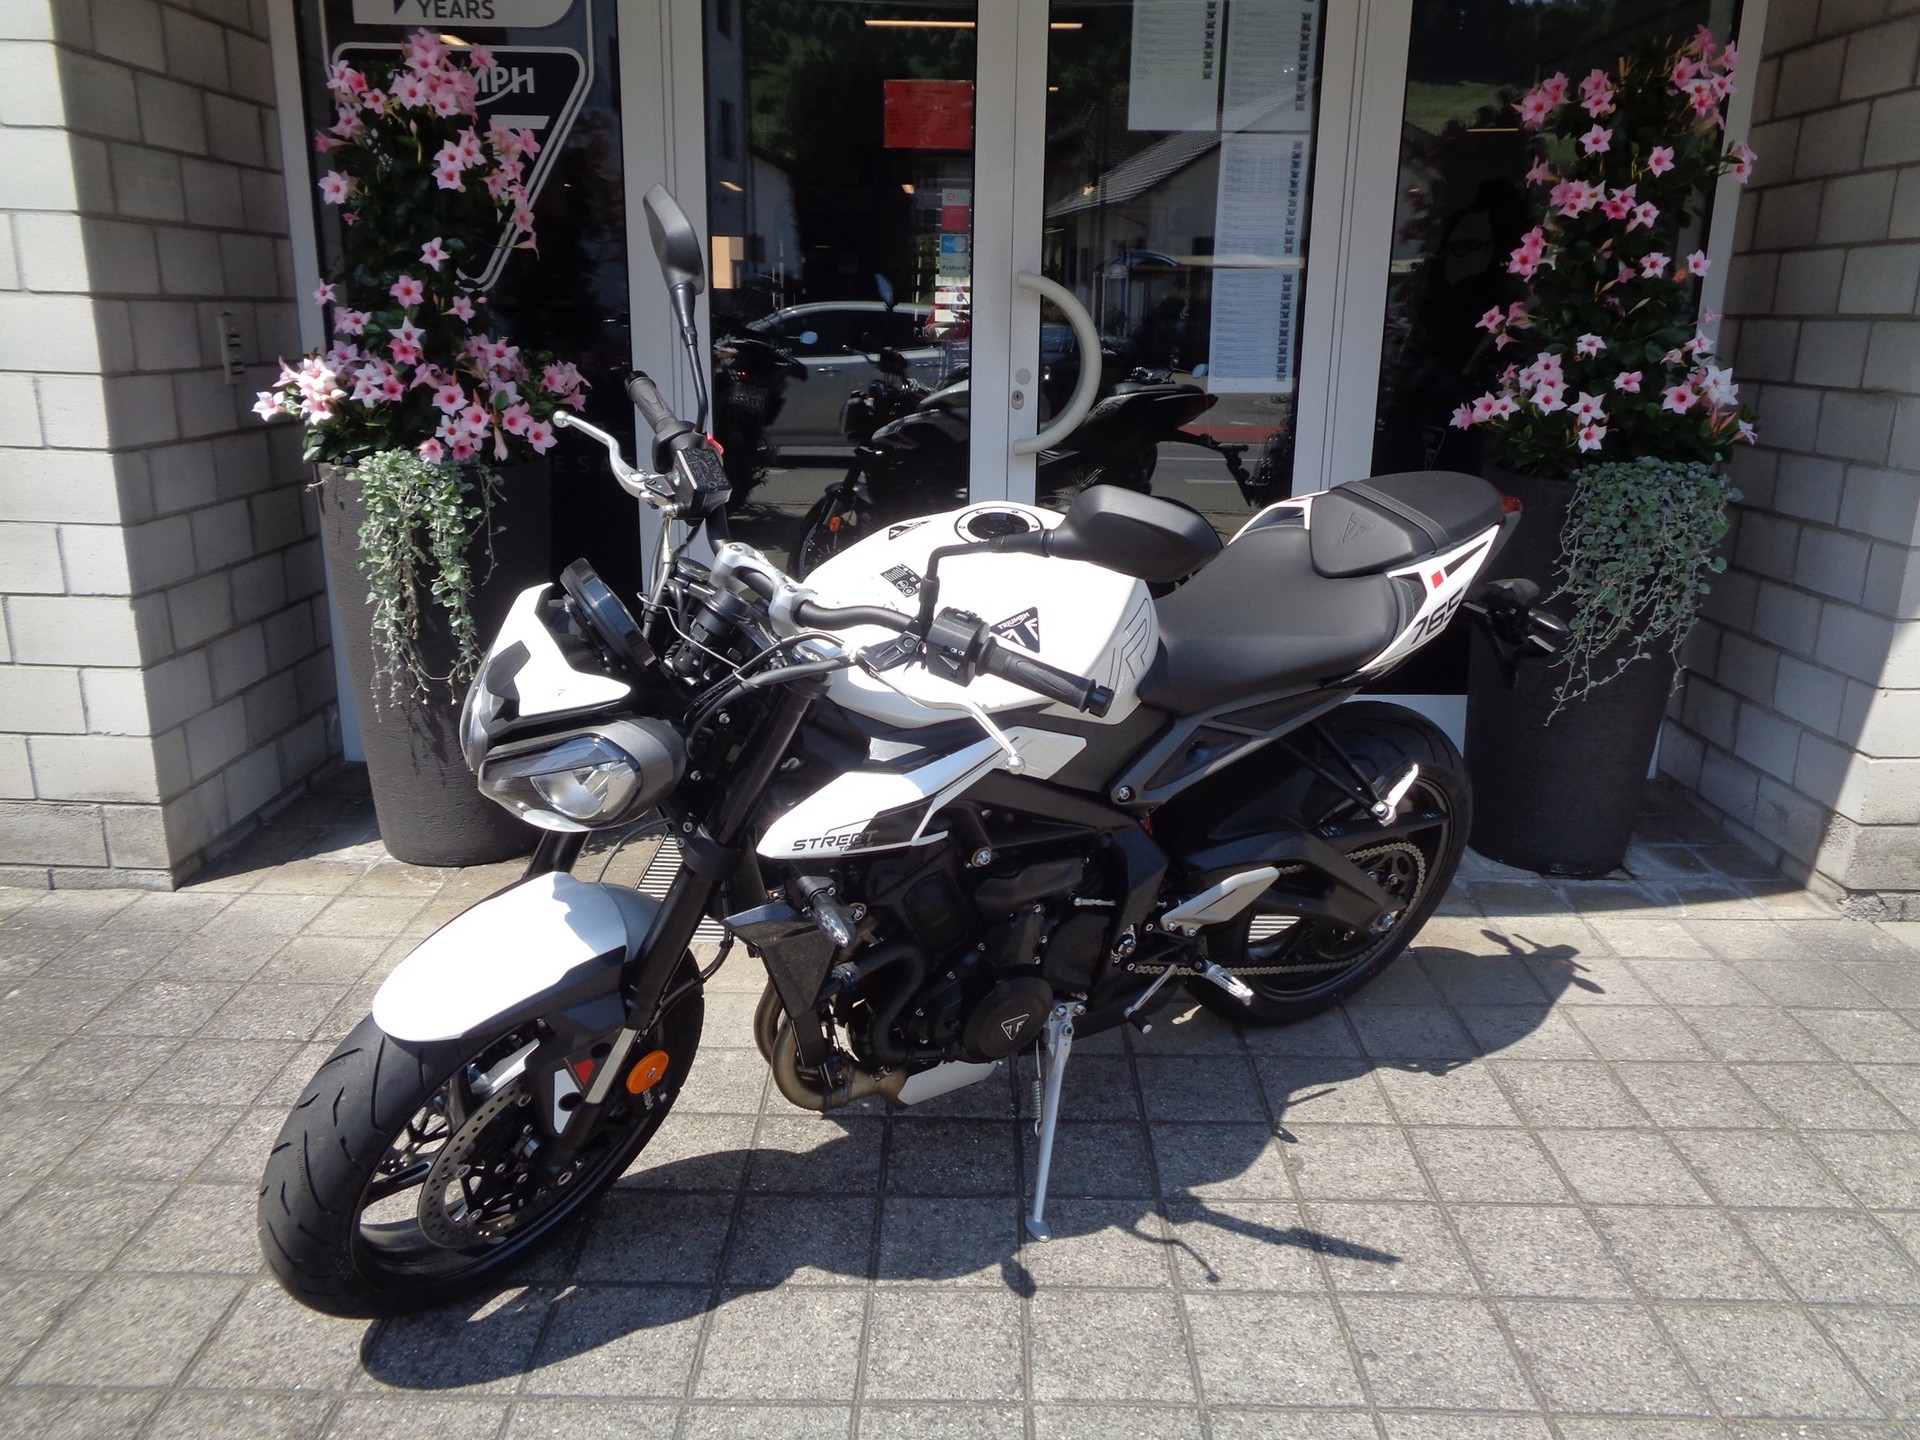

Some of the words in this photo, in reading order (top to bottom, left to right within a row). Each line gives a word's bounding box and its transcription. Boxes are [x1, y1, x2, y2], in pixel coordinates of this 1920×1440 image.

[416, 0, 494, 19] YEARS
[997, 612, 1030, 629] TRIUMPH
[1411, 586, 1463, 645] 765
[792, 830, 878, 851] STREET
